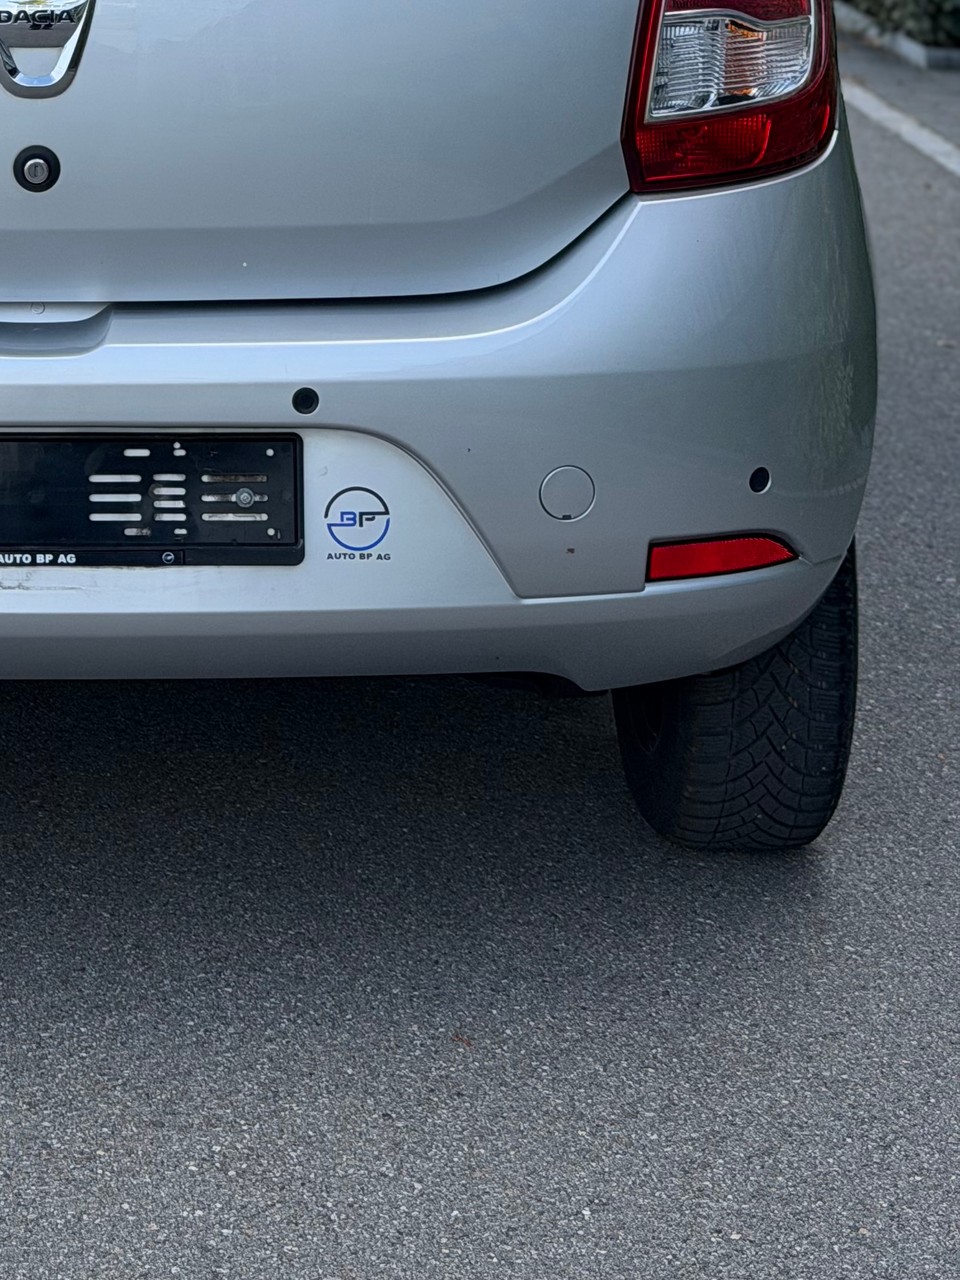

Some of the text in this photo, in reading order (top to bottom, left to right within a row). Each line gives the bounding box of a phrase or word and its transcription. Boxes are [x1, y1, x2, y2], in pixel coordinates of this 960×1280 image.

[36, 553, 54, 564] BP
[57, 553, 77, 564] AG
[326, 552, 392, 562] AUTO BP AG
